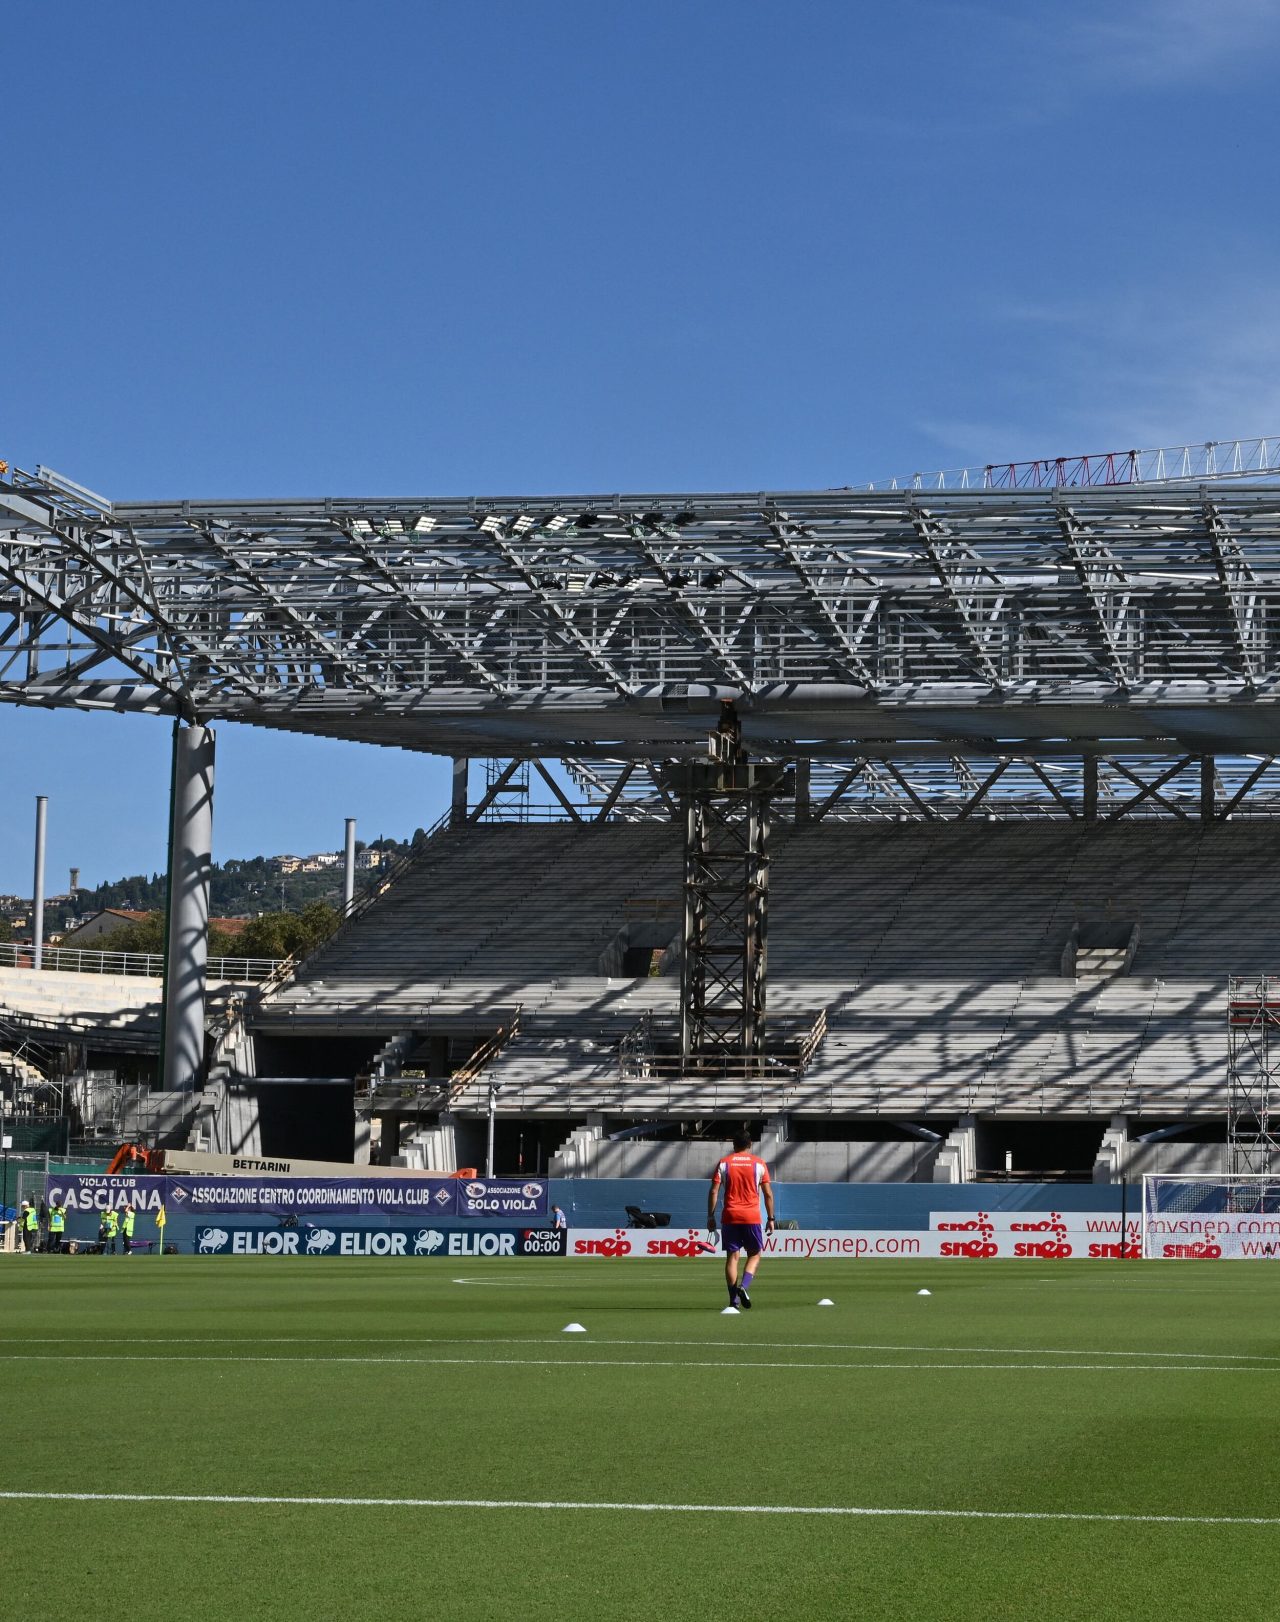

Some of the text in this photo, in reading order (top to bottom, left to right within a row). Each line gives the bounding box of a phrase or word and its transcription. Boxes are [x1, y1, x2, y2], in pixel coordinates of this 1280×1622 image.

[232, 1159, 291, 1173] BETTARINI
[78, 1177, 136, 1187] VIOLA CLUB
[49, 1188, 162, 1210] CASCIANA
[191, 1187, 430, 1205] ASSOCIAZIONE CENTRO COORDINAMENTO VIOLA CLUB
[467, 1199, 537, 1210] SOLO VIOLA
[528, 1231, 561, 1240] NGM
[232, 1231, 516, 1256] ELIOR ELIOR ELIOR
[524, 1240, 560, 1252] 00:00
[762, 1238, 920, 1258] w.mysnep.com
